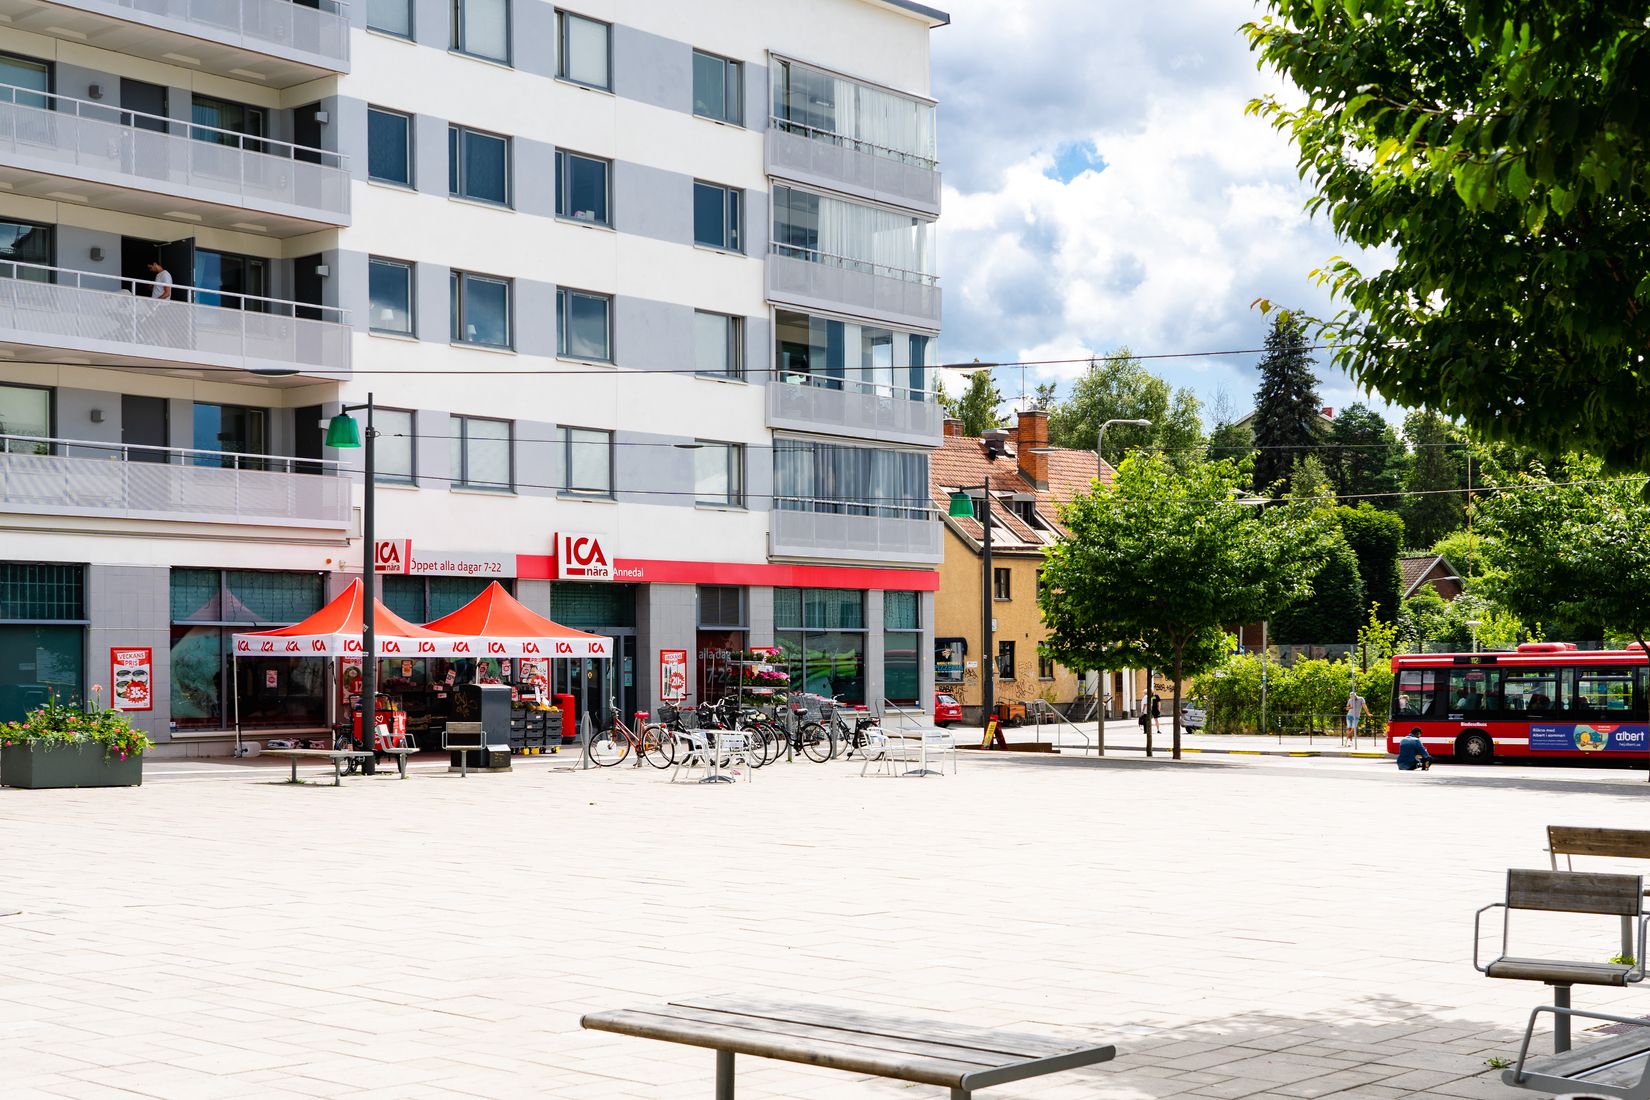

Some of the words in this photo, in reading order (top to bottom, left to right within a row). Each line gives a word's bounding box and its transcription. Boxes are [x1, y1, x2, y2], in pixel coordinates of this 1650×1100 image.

[375, 541, 400, 563] ICA
[565, 536, 607, 566] ICA
[440, 560, 455, 571] alla
[457, 560, 482, 574] dagar
[484, 562, 502, 572] 7-22
[586, 565, 609, 577] nära
[613, 567, 644, 577] Annedal
[237, 640, 251, 652] ICA
[260, 641, 275, 652] ICA
[285, 640, 300, 652] ICA
[312, 639, 327, 652] ICA
[343, 639, 363, 652] ICA
[381, 641, 401, 653] ICA
[418, 641, 436, 653] ICA
[452, 641, 471, 653] ICA
[488, 642, 506, 654] ICA
[522, 642, 540, 654] ICA
[555, 642, 573, 654] ICA
[588, 642, 605, 654] ICA
[698, 648, 715, 659] alla
[715, 648, 731, 664] dag
[1615, 731, 1645, 741] albert
